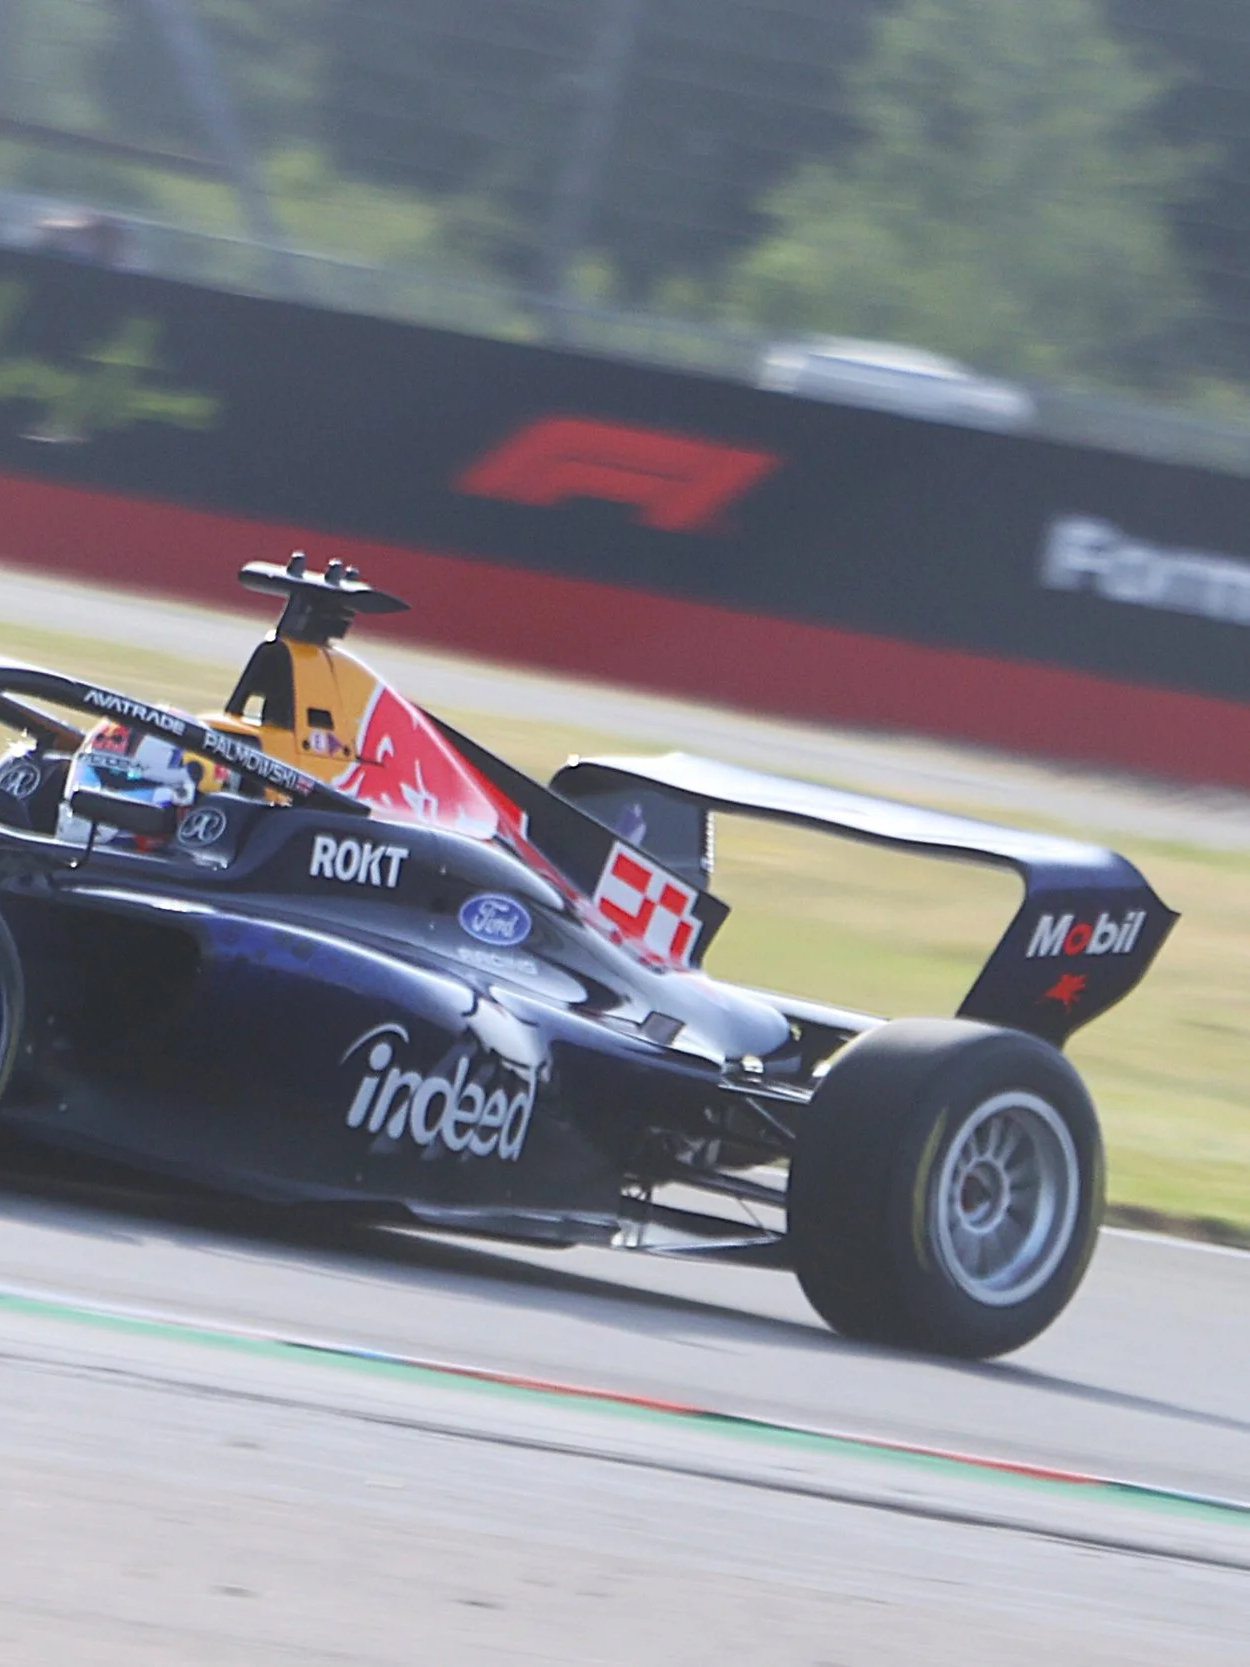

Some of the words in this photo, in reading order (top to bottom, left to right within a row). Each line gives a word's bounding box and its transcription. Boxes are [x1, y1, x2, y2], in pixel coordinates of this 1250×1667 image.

[84, 690, 186, 736] AVATRADE
[203, 729, 297, 790] PALMOWSKI
[309, 835, 410, 889] ROKT
[471, 900, 519, 937] Ford
[1026, 908, 1147, 958] Mobil
[345, 1040, 537, 1162] indeed
